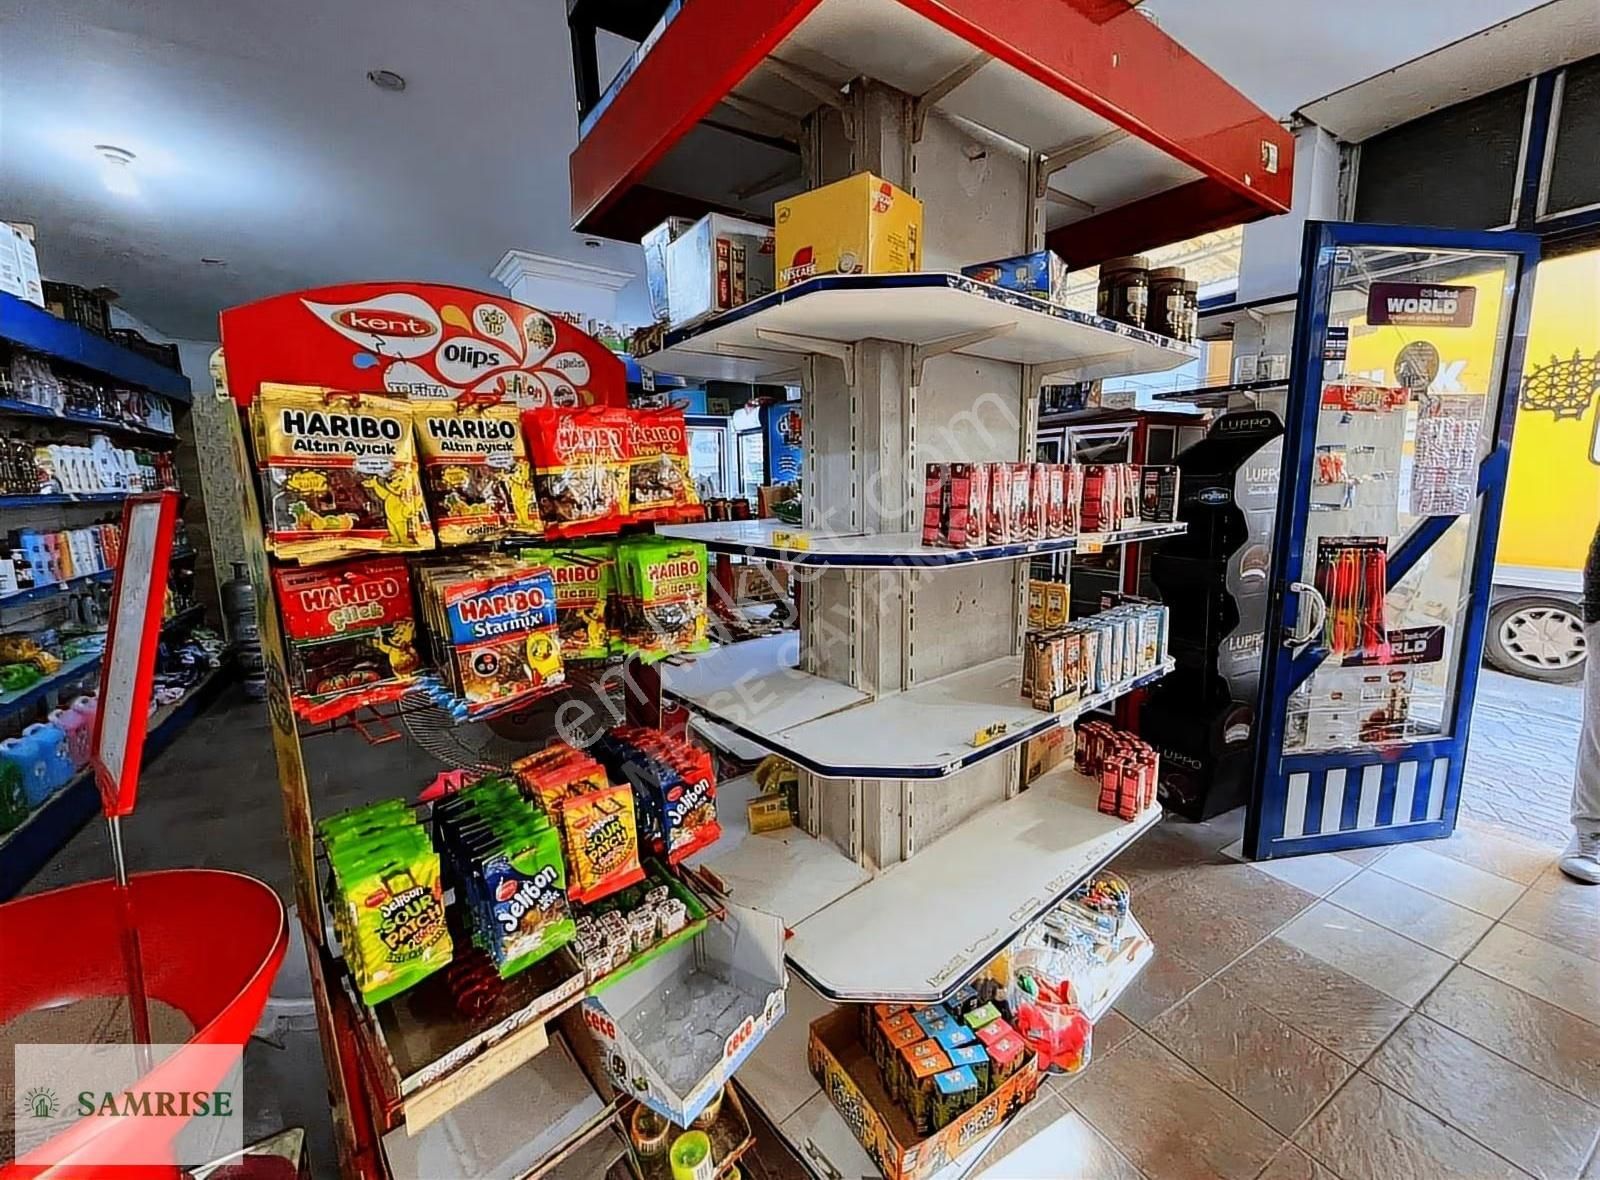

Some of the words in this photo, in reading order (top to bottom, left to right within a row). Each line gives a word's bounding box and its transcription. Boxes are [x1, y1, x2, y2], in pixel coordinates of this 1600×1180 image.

[1387, 297, 1457, 315] WORLD
[350, 312, 425, 335] kent
[444, 344, 499, 368] Olips
[283, 411, 401, 440] HARIBO
[428, 419, 515, 439] HARIBO
[1220, 417, 1271, 431] LUPPO
[294, 439, 339, 451] Altın
[344, 441, 396, 455] Ayıcık
[441, 442, 473, 452] Altın
[476, 442, 514, 453] Ayıcık
[648, 560, 700, 581] HARIBO
[301, 578, 400, 612] HARIBO
[459, 587, 545, 623] HARIBO
[668, 778, 710, 824] Jelibon
[588, 820, 621, 851] SOUR
[589, 829, 628, 863] PATCH
[381, 886, 424, 918] Jelibon
[498, 866, 557, 931] Jelibon
[381, 894, 434, 934] SOUR
[385, 903, 441, 949] PATCH
